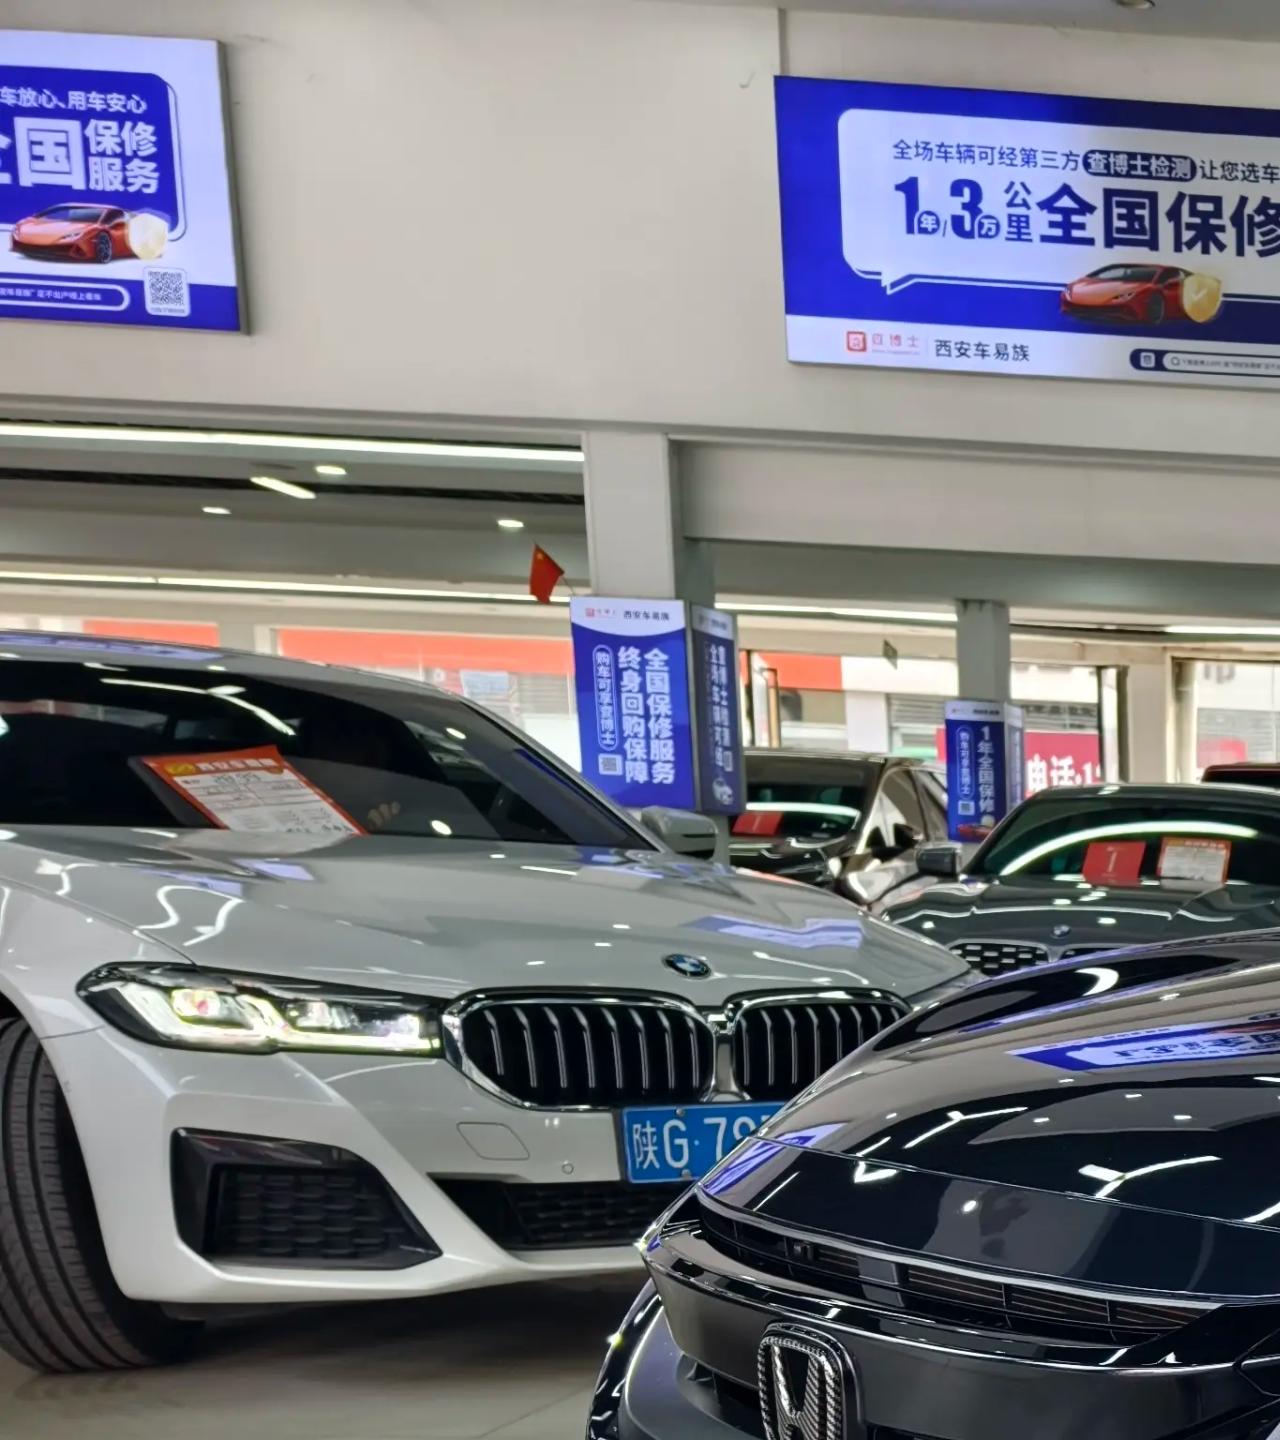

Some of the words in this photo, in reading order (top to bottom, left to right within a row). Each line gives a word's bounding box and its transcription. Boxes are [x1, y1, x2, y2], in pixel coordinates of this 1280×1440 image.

[84, 119, 158, 157] 保修
[88, 156, 160, 194] 服务
[935, 338, 1030, 362] 西安车易族
[617, 645, 649, 784] 终身回购保障
[643, 648, 676, 785] 全国保修服务
